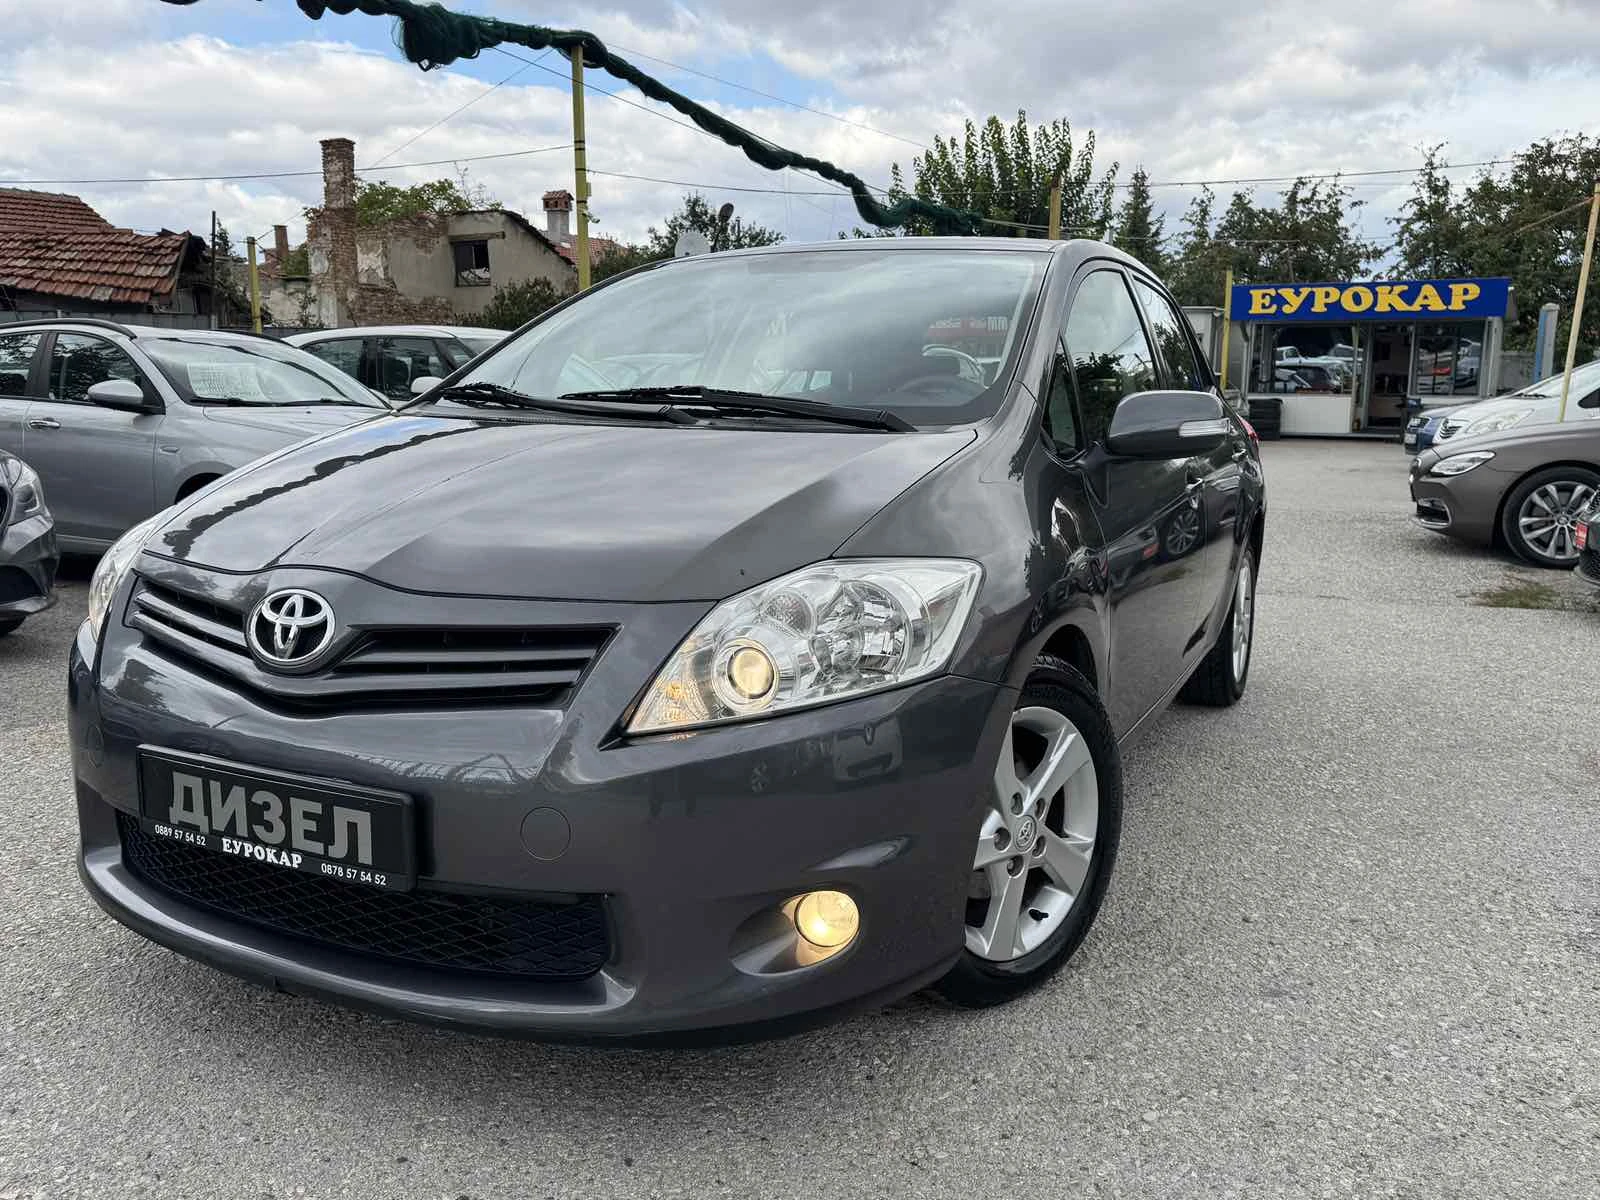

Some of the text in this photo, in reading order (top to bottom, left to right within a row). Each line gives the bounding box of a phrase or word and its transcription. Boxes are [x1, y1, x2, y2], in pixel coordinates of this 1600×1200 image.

[1248, 283, 1481, 315] ЕУРОКАР
[168, 771, 373, 865] ДИЗЕЛ
[154, 824, 207, 846] 0889 57 54 52
[221, 836, 302, 869] ЕУРОКАР
[321, 863, 387, 886] 0878 57 54 52
